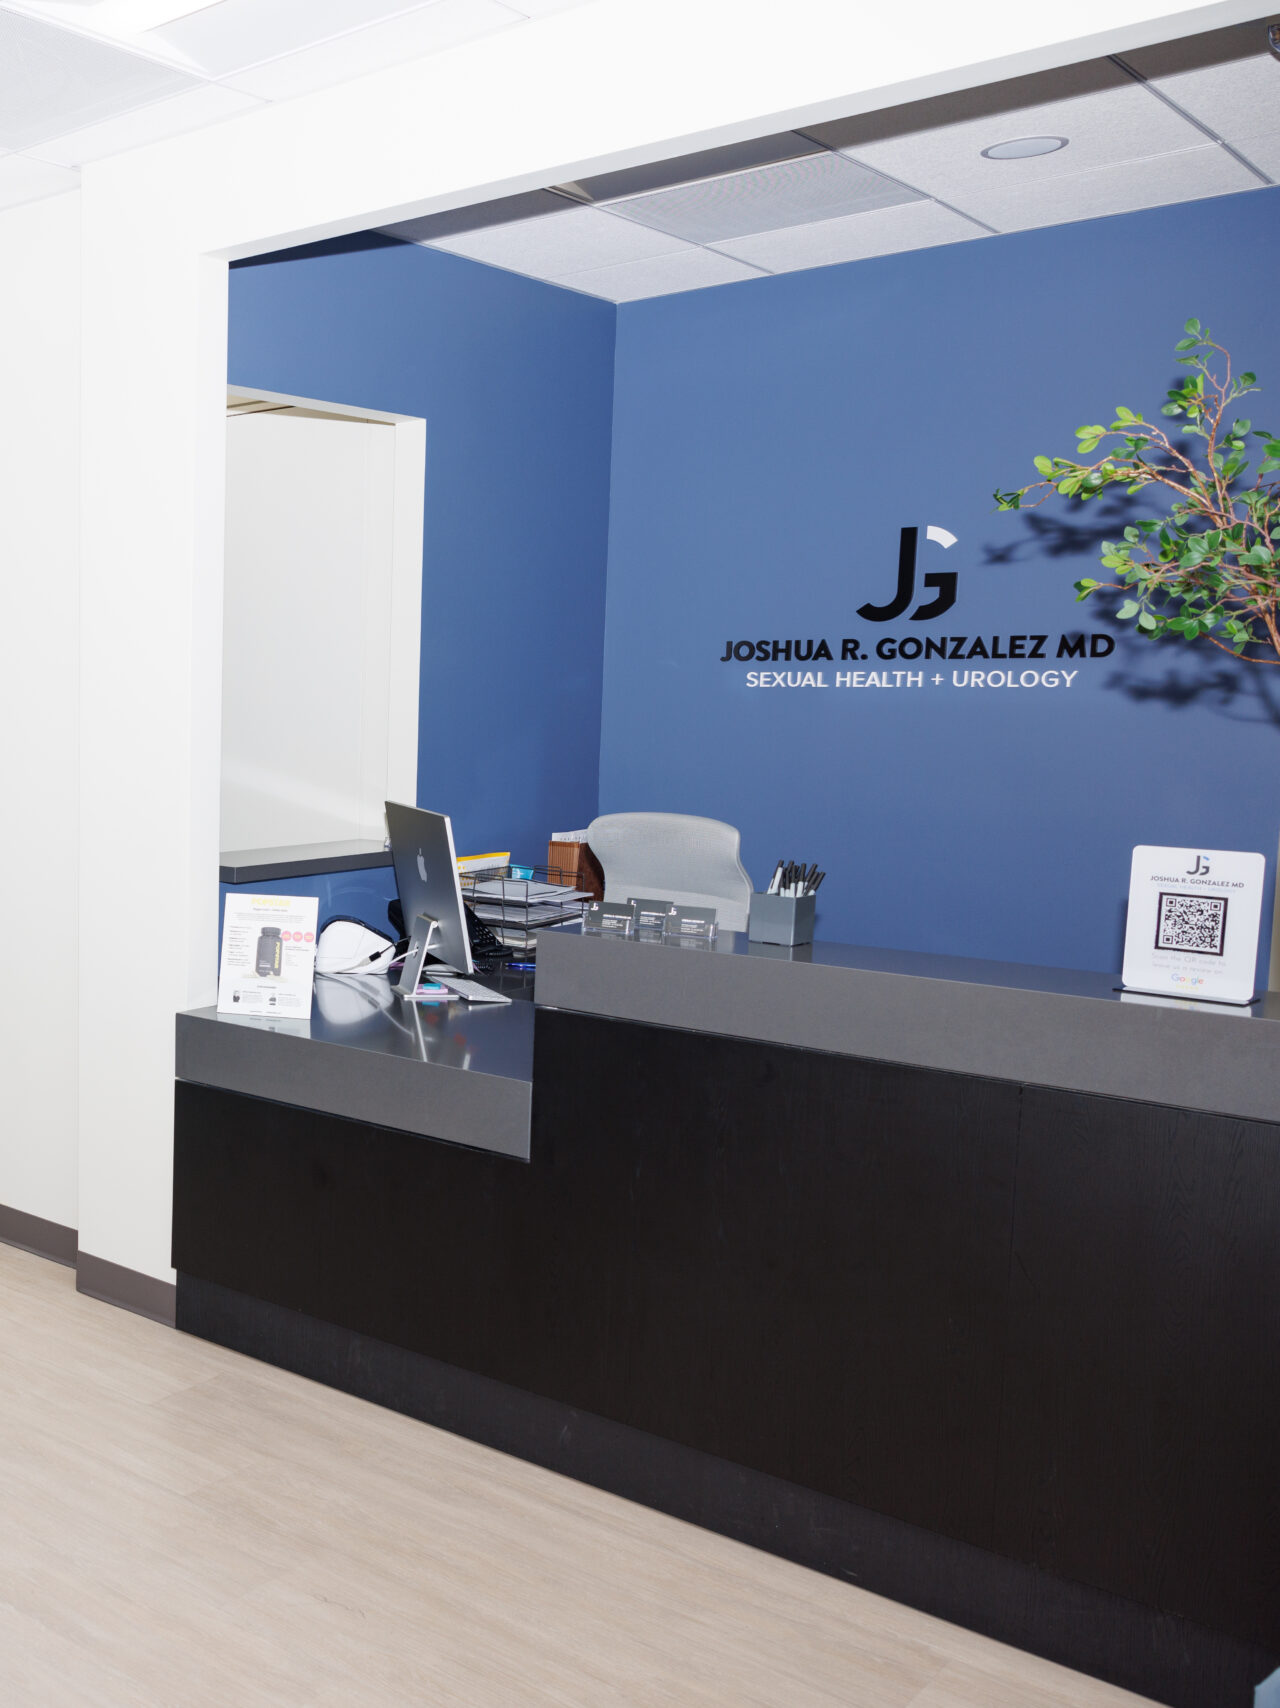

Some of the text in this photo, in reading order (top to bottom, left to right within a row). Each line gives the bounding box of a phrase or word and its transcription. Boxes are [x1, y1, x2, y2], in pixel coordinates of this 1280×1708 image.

[720, 633, 1115, 662] JOSHUA R. GONZALEZ MD
[745, 669, 1078, 689] SEXUAL HEALTH + UROLOGY
[1150, 875, 1180, 884] JOSHUA
[1190, 878, 1230, 888] GONZALEZ
[1231, 881, 1245, 889] MD
